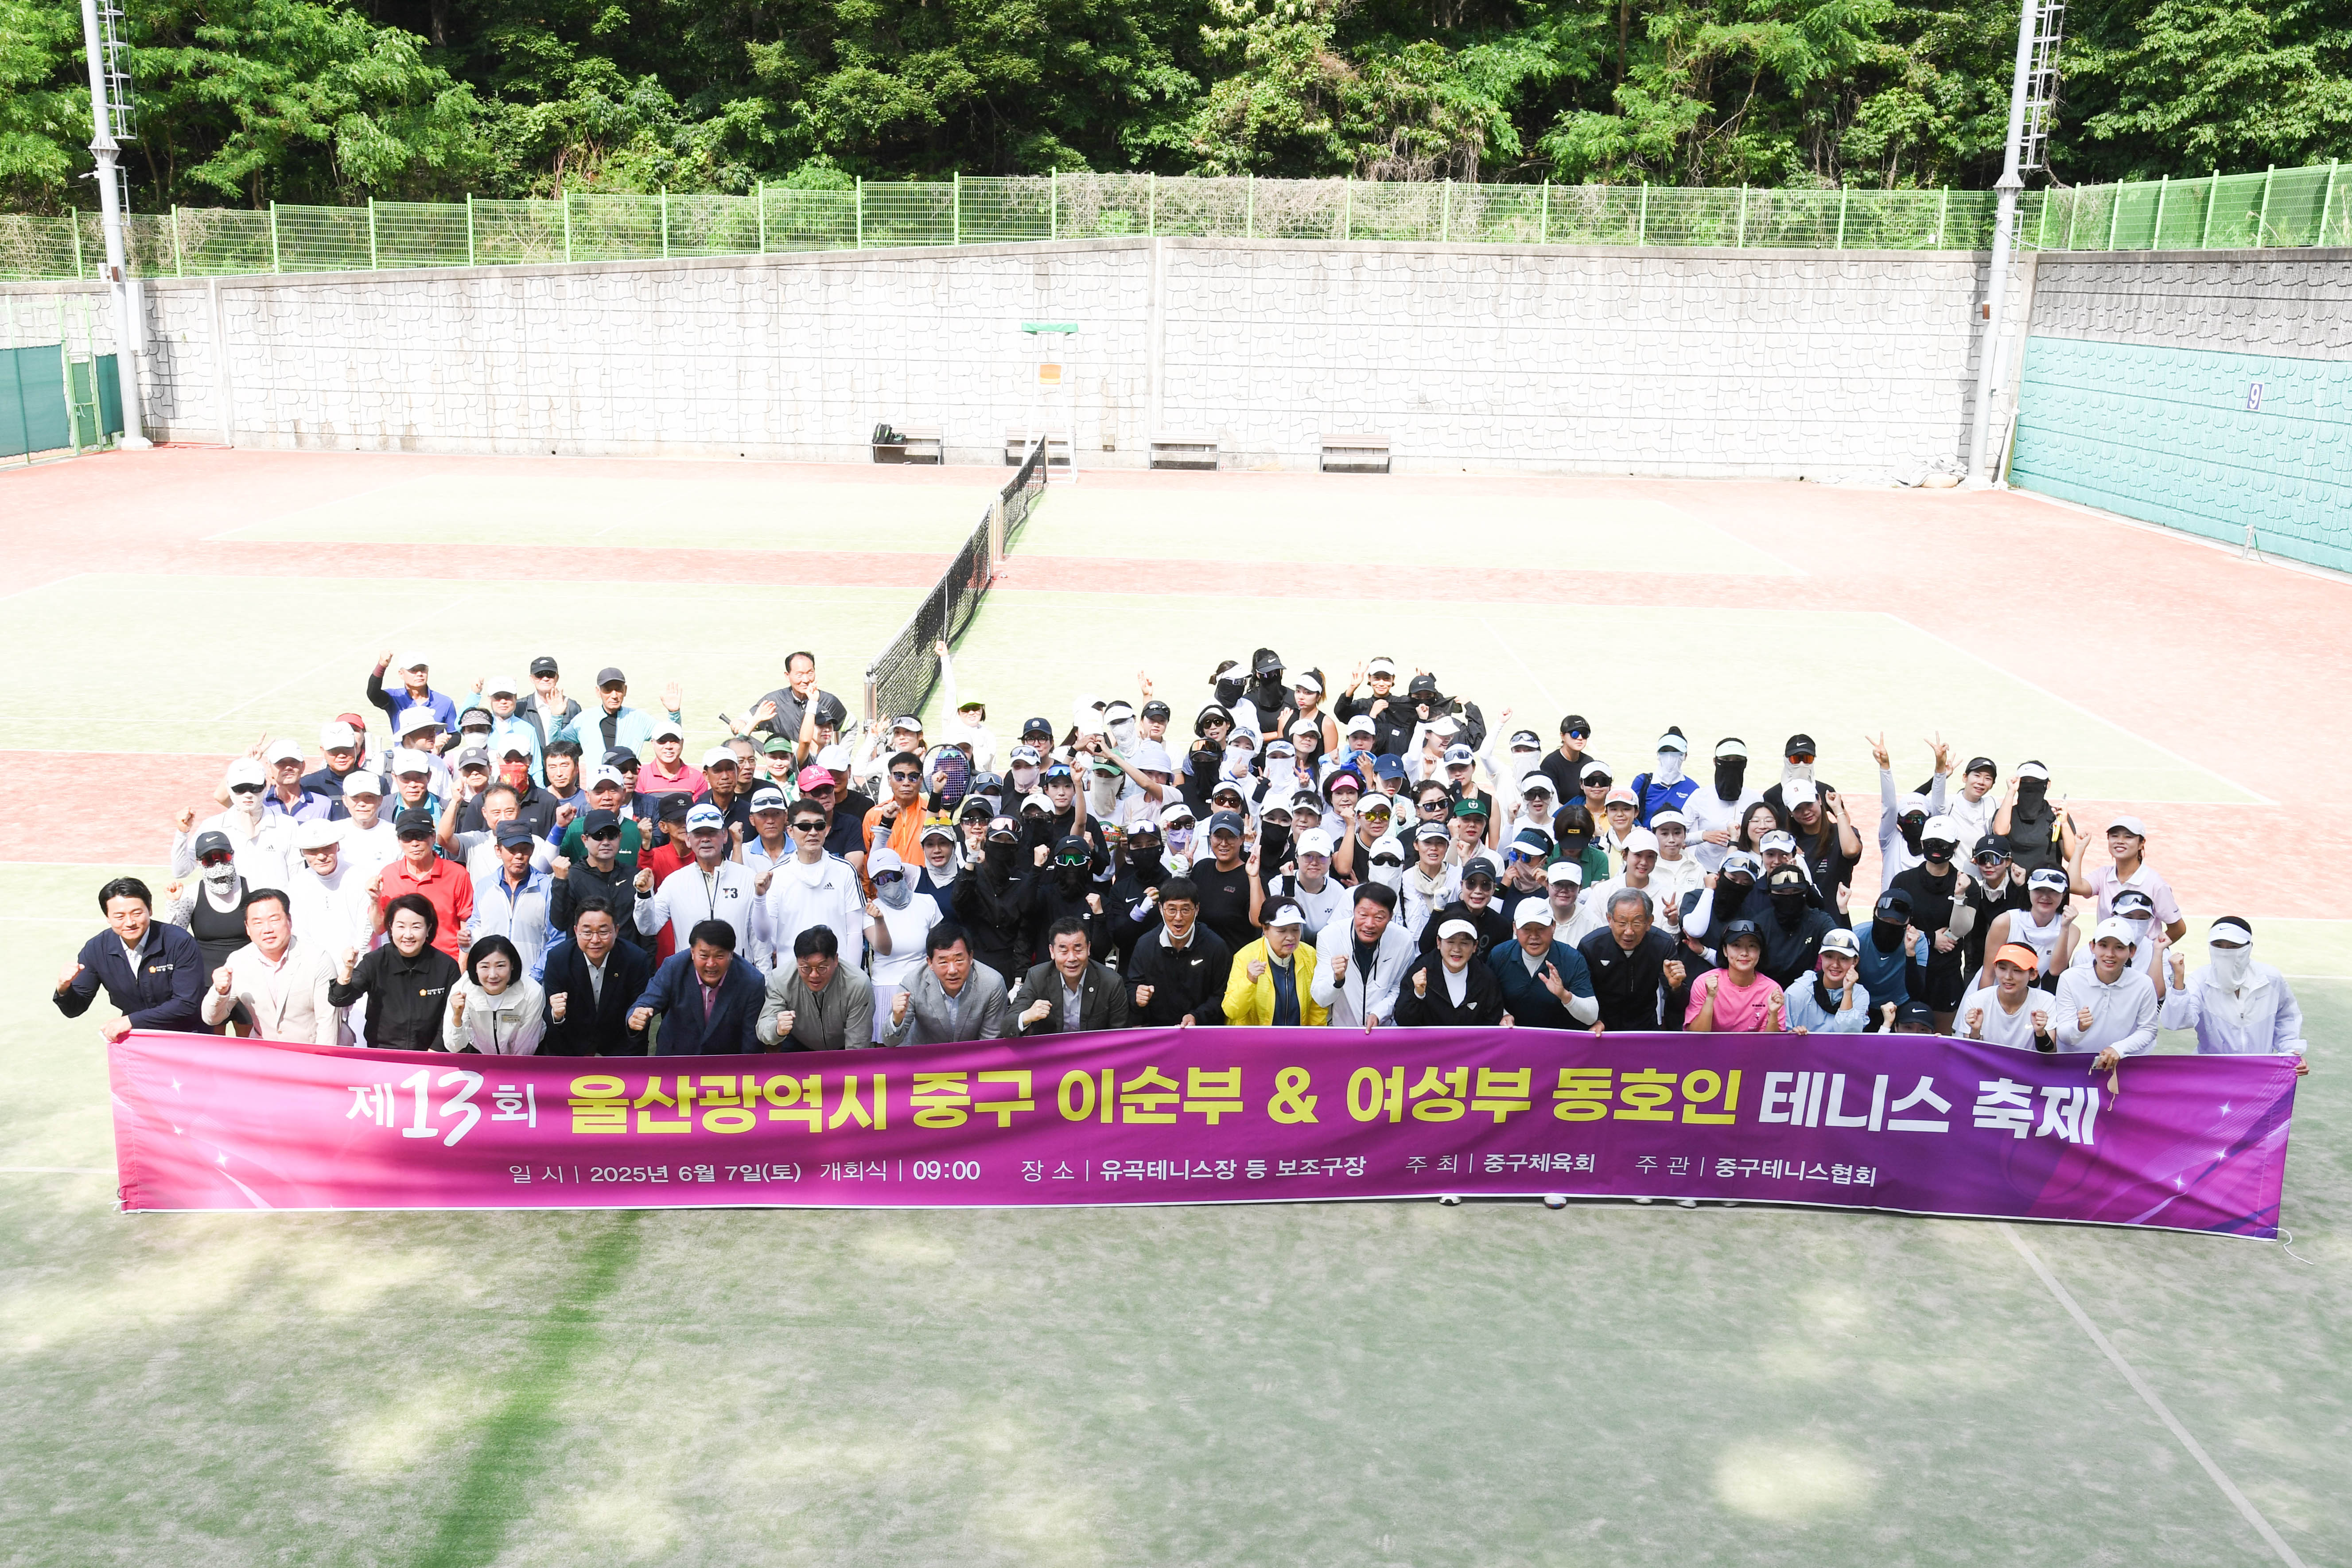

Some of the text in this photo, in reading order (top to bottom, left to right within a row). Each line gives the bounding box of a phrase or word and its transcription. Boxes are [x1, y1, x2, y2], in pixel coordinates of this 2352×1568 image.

[2249, 384, 2260, 409] 9
[723, 887, 739, 899] T3
[567, 1074, 886, 1133] 울산광역시
[910, 1070, 1034, 1128] 중구
[1057, 1066, 1243, 1124] 이순부
[1267, 1066, 1318, 1124] &
[1347, 1066, 1531, 1123] 여성부
[1552, 1068, 1741, 1124] 동호인
[1758, 1071, 1952, 1132] 테니스
[1972, 1077, 2099, 1145] 축제
[590, 1165, 668, 1182] 2025년
[679, 1164, 715, 1182] 6월
[724, 1163, 800, 1182] 7일(토)
[820, 1160, 886, 1181] 개회식
[913, 1160, 980, 1180] 09:00
[1100, 1159, 1237, 1181] 유곡테니스장
[1245, 1160, 1267, 1179] 등
[1275, 1156, 1367, 1177] 보조구장
[1483, 1153, 1594, 1173] 중구체육회
[1715, 1158, 1876, 1187] 중구테니스협회
